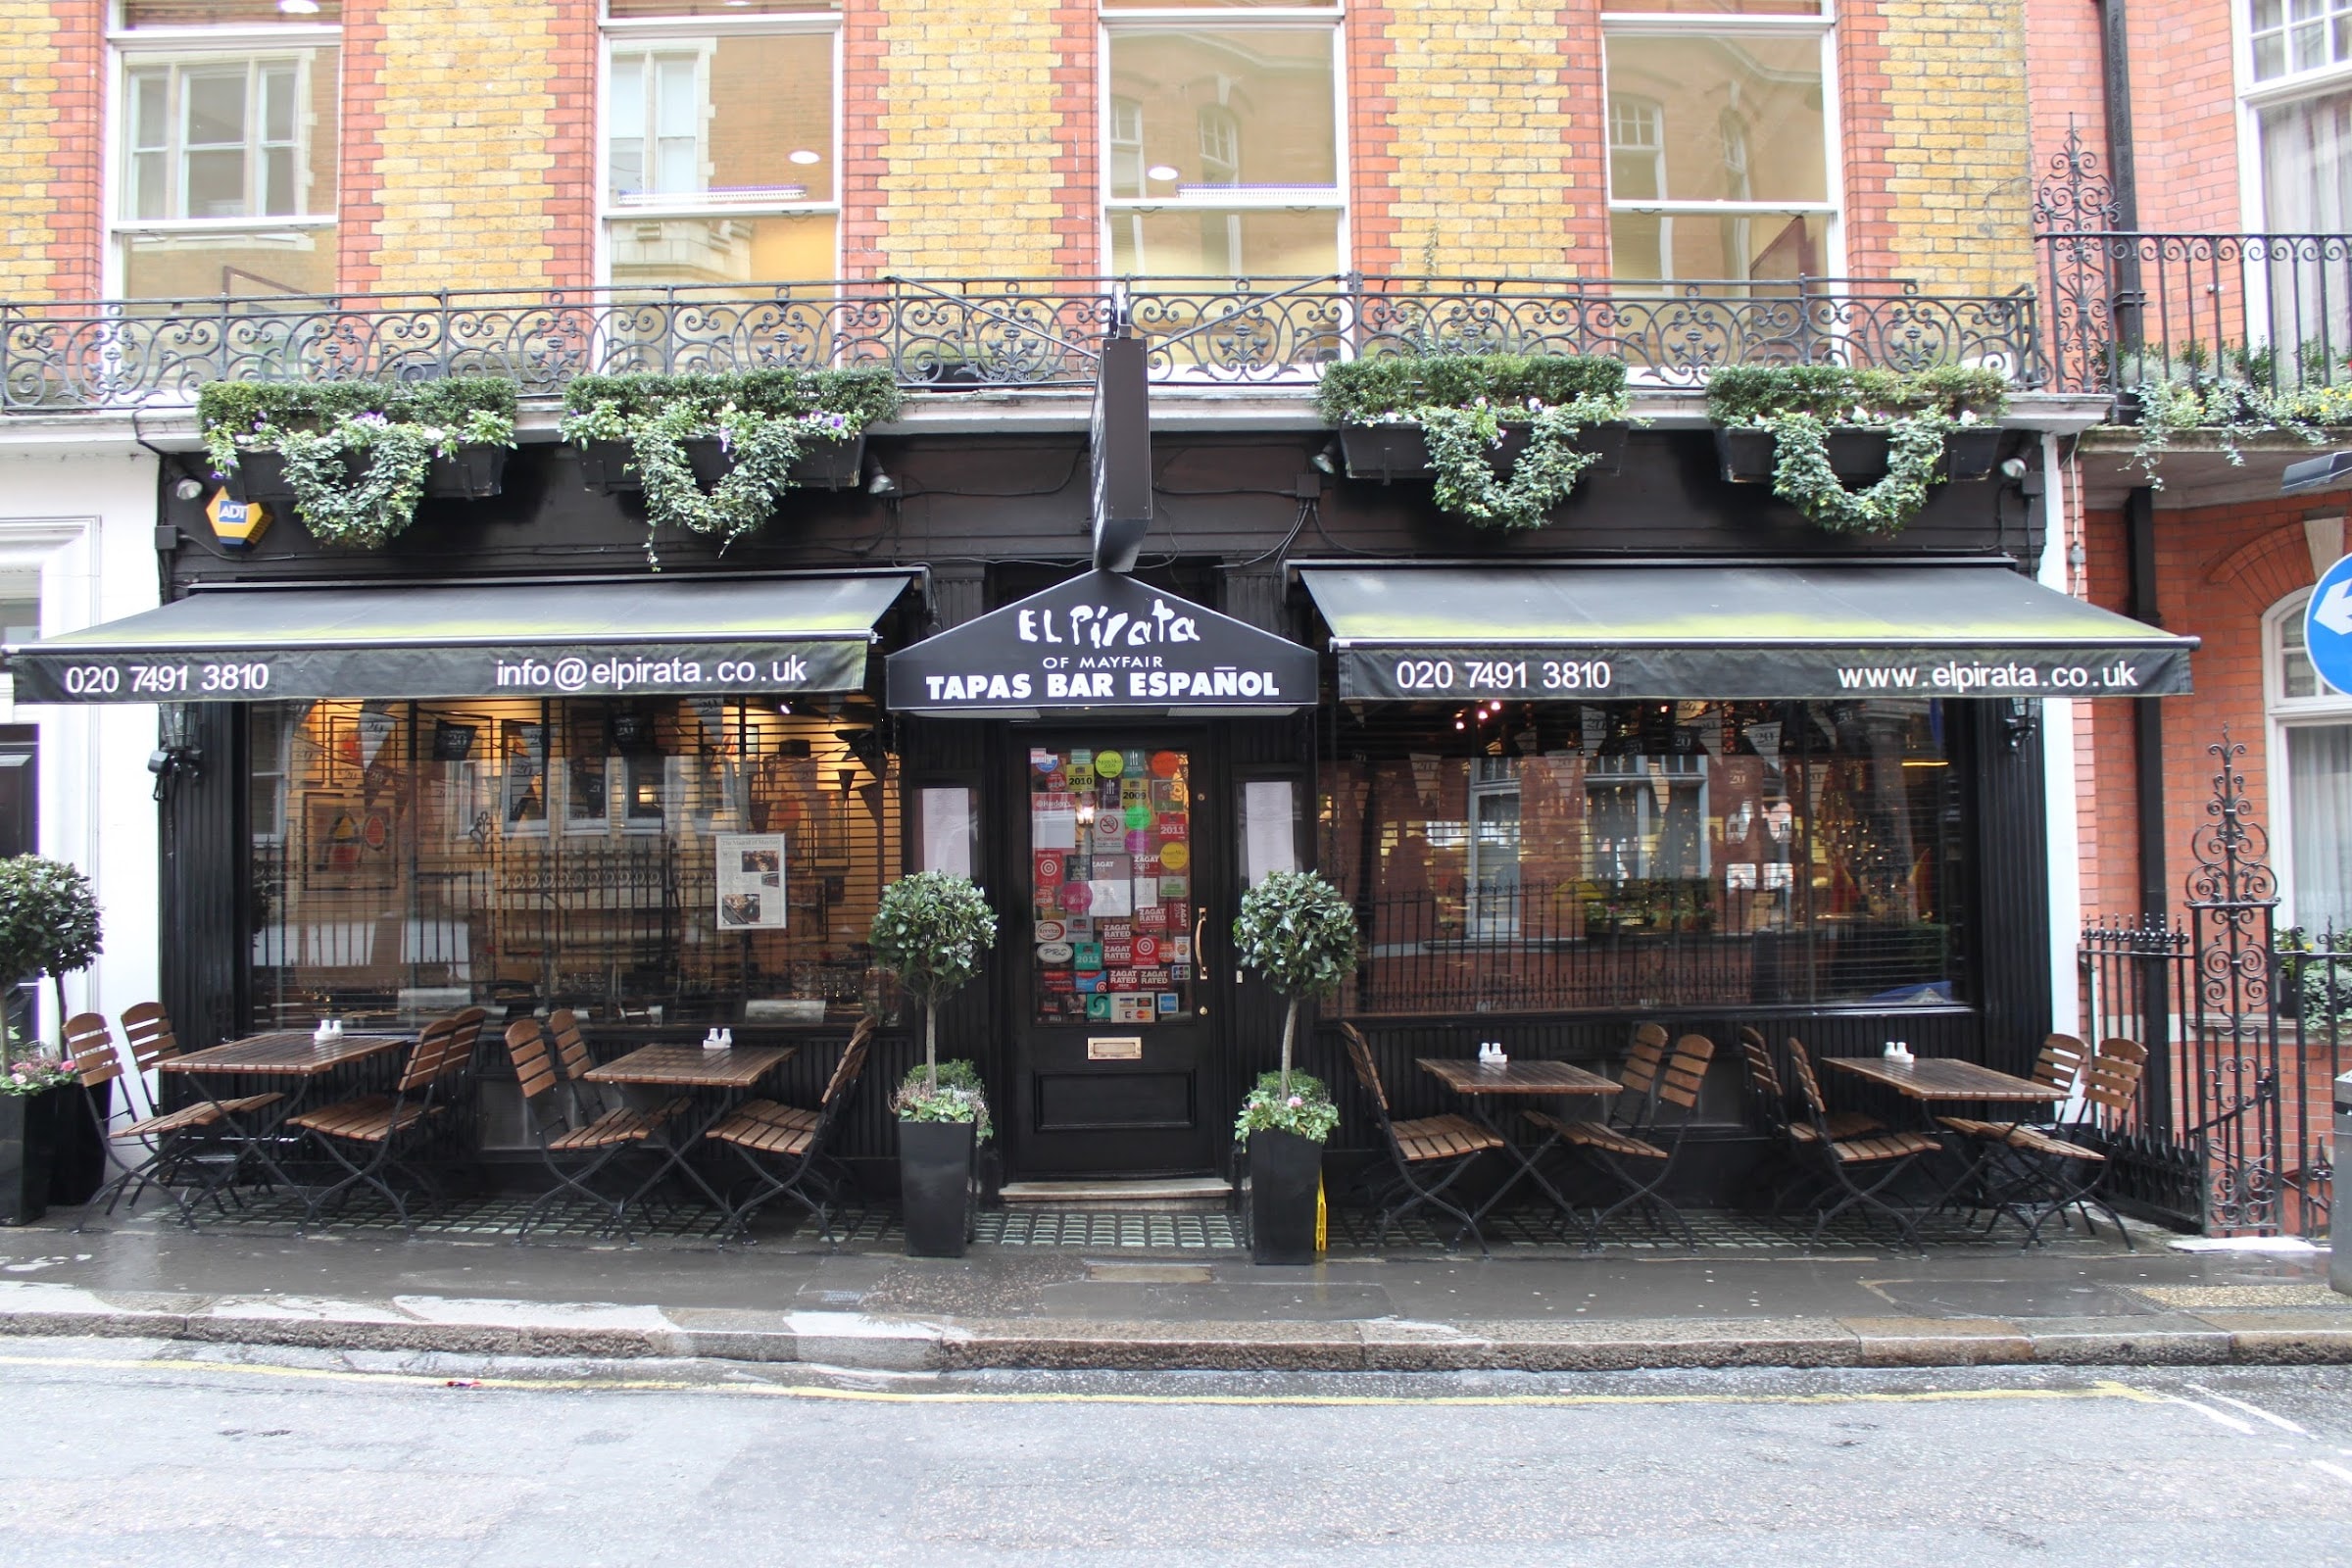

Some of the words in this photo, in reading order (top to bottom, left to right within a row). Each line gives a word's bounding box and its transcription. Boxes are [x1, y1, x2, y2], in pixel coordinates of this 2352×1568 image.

[219, 505, 248, 518] ADT
[1043, 658, 1069, 669] OF
[1080, 657, 1163, 669] MAYFAIR
[66, 665, 120, 694] 020
[130, 664, 189, 693] 7491
[201, 662, 270, 692] 3810
[497, 654, 808, 692] info@elpirata.co.uk
[1396, 662, 1454, 689] 020
[1466, 662, 1527, 689] 7491
[1543, 662, 1611, 689] 3810
[926, 673, 1032, 700] TAPAS
[1048, 672, 1114, 697] BAR
[1130, 666, 1280, 697] ESPAÑOL
[366, 721, 384, 733] 20
[448, 734, 467, 746] 20
[1755, 732, 1774, 743] 20
[1729, 775, 1745, 784] 20
